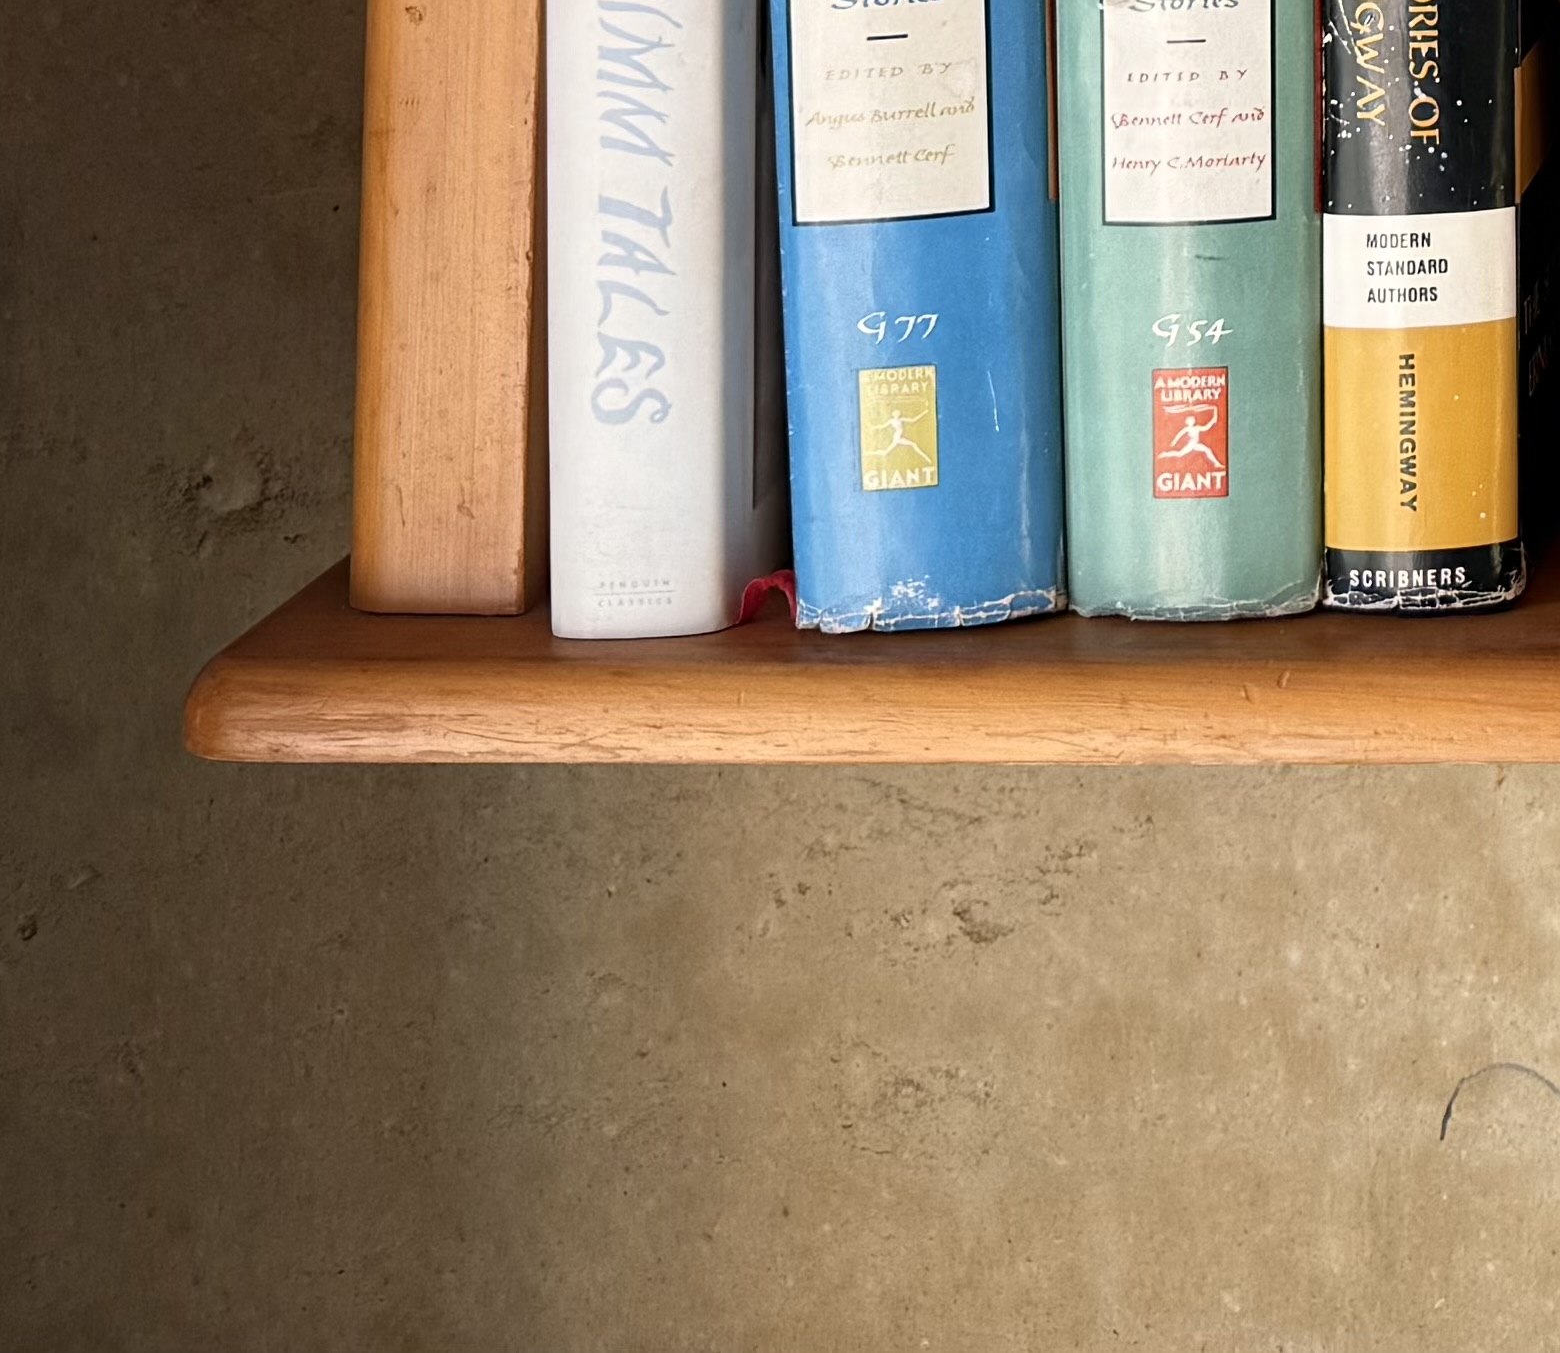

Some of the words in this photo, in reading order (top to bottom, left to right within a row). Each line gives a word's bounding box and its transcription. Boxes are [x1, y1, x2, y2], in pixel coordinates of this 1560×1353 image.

[825, 66, 904, 81] EDITED
[919, 61, 953, 75] BY
[1127, 71, 1200, 84] EDITED
[1219, 69, 1248, 81] BY
[805, 110, 865, 130] Angus
[870, 101, 936, 123] Burrell
[939, 96, 975, 117] and
[1111, 112, 1182, 130] Bennett
[1188, 107, 1229, 128] Cerf
[1231, 106, 1265, 123] and
[1408, 95, 1441, 146] OF
[828, 150, 912, 170] Bennett
[914, 144, 956, 165] Cerf
[1112, 156, 1162, 177] Henry
[1366, 232, 1432, 250] MODERN
[1366, 258, 1449, 277] STANDARD
[1367, 286, 1439, 304] AUTHORS
[591, 185, 684, 426] TALES
[874, 366, 935, 382] MODERN
[1154, 376, 1166, 390] A
[1167, 374, 1226, 389] MODERN
[866, 381, 929, 396] LIBRARY
[1161, 388, 1222, 403] LIBRARY
[1398, 353, 1418, 513] HEMINGWAY
[864, 465, 935, 489] GIANT
[1156, 471, 1227, 492] GIANT
[600, 578, 670, 590] PENGUIN
[1349, 565, 1467, 588] SCRIBNERS
